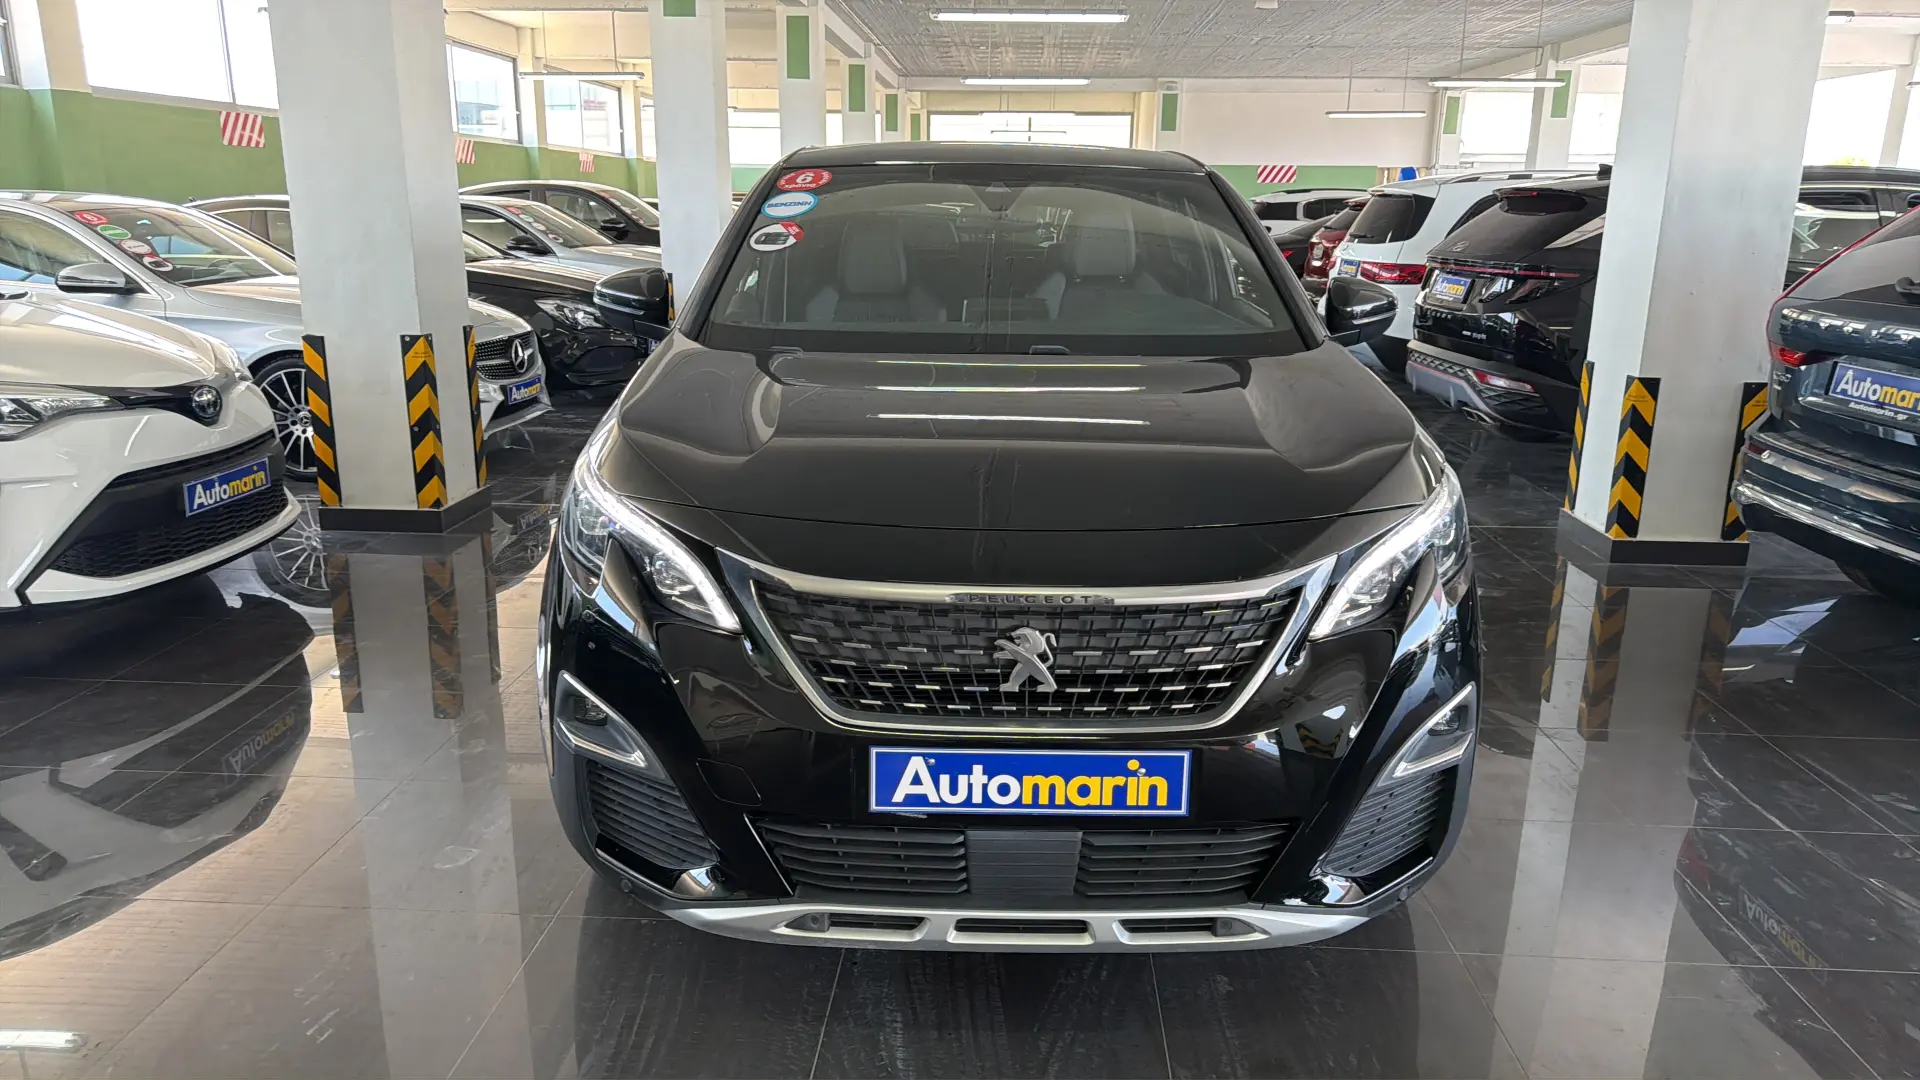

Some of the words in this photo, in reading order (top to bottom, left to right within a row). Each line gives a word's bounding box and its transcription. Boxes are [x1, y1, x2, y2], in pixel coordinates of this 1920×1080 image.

[796, 173, 815, 184] 6
[1836, 369, 1920, 410] Automar
[1848, 402, 1909, 421] Automarin.gr
[193, 465, 266, 510] Automarin
[967, 594, 1091, 605] PEUGEOT
[891, 756, 1168, 806] Automarin
